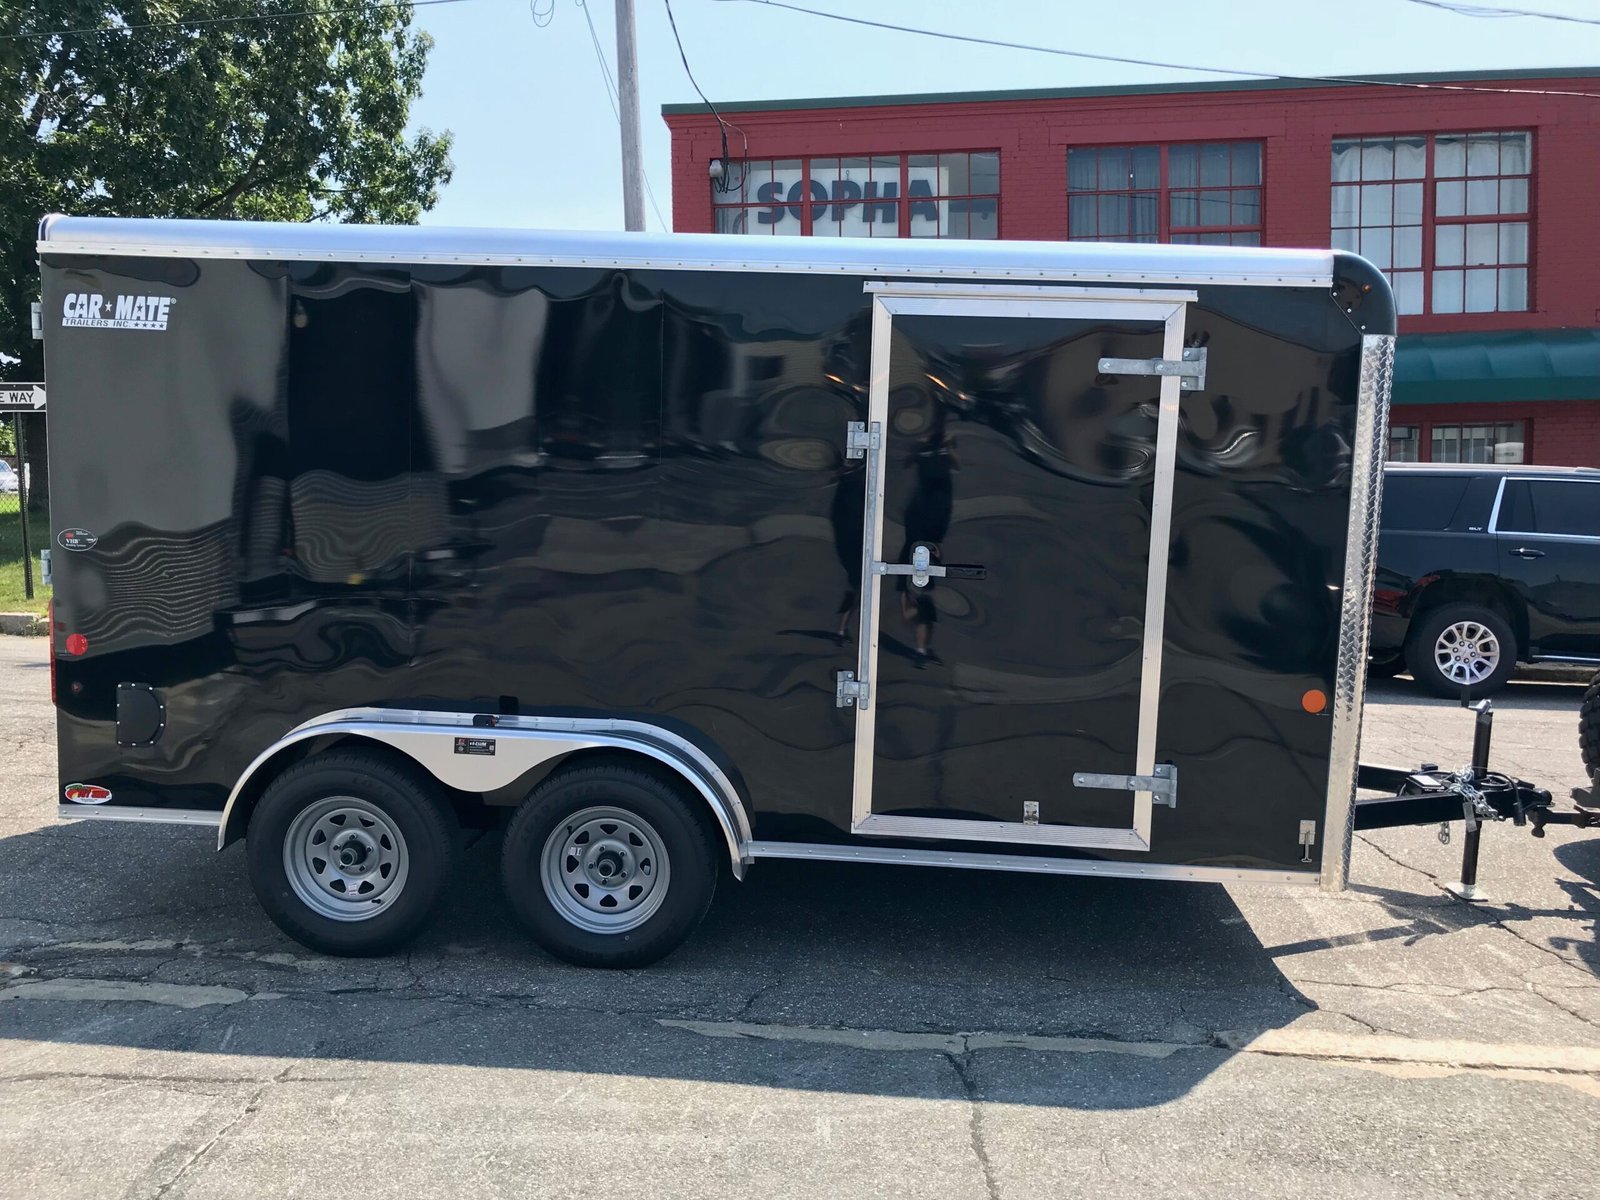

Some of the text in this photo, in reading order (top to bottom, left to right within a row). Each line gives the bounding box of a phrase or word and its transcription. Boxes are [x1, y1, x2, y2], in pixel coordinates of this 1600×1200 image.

[757, 179, 939, 225] SOPHA
[63, 292, 171, 321] CAR MATE
[65, 318, 132, 328] TRAILERS INC.
[9, 392, 34, 402] WAY
